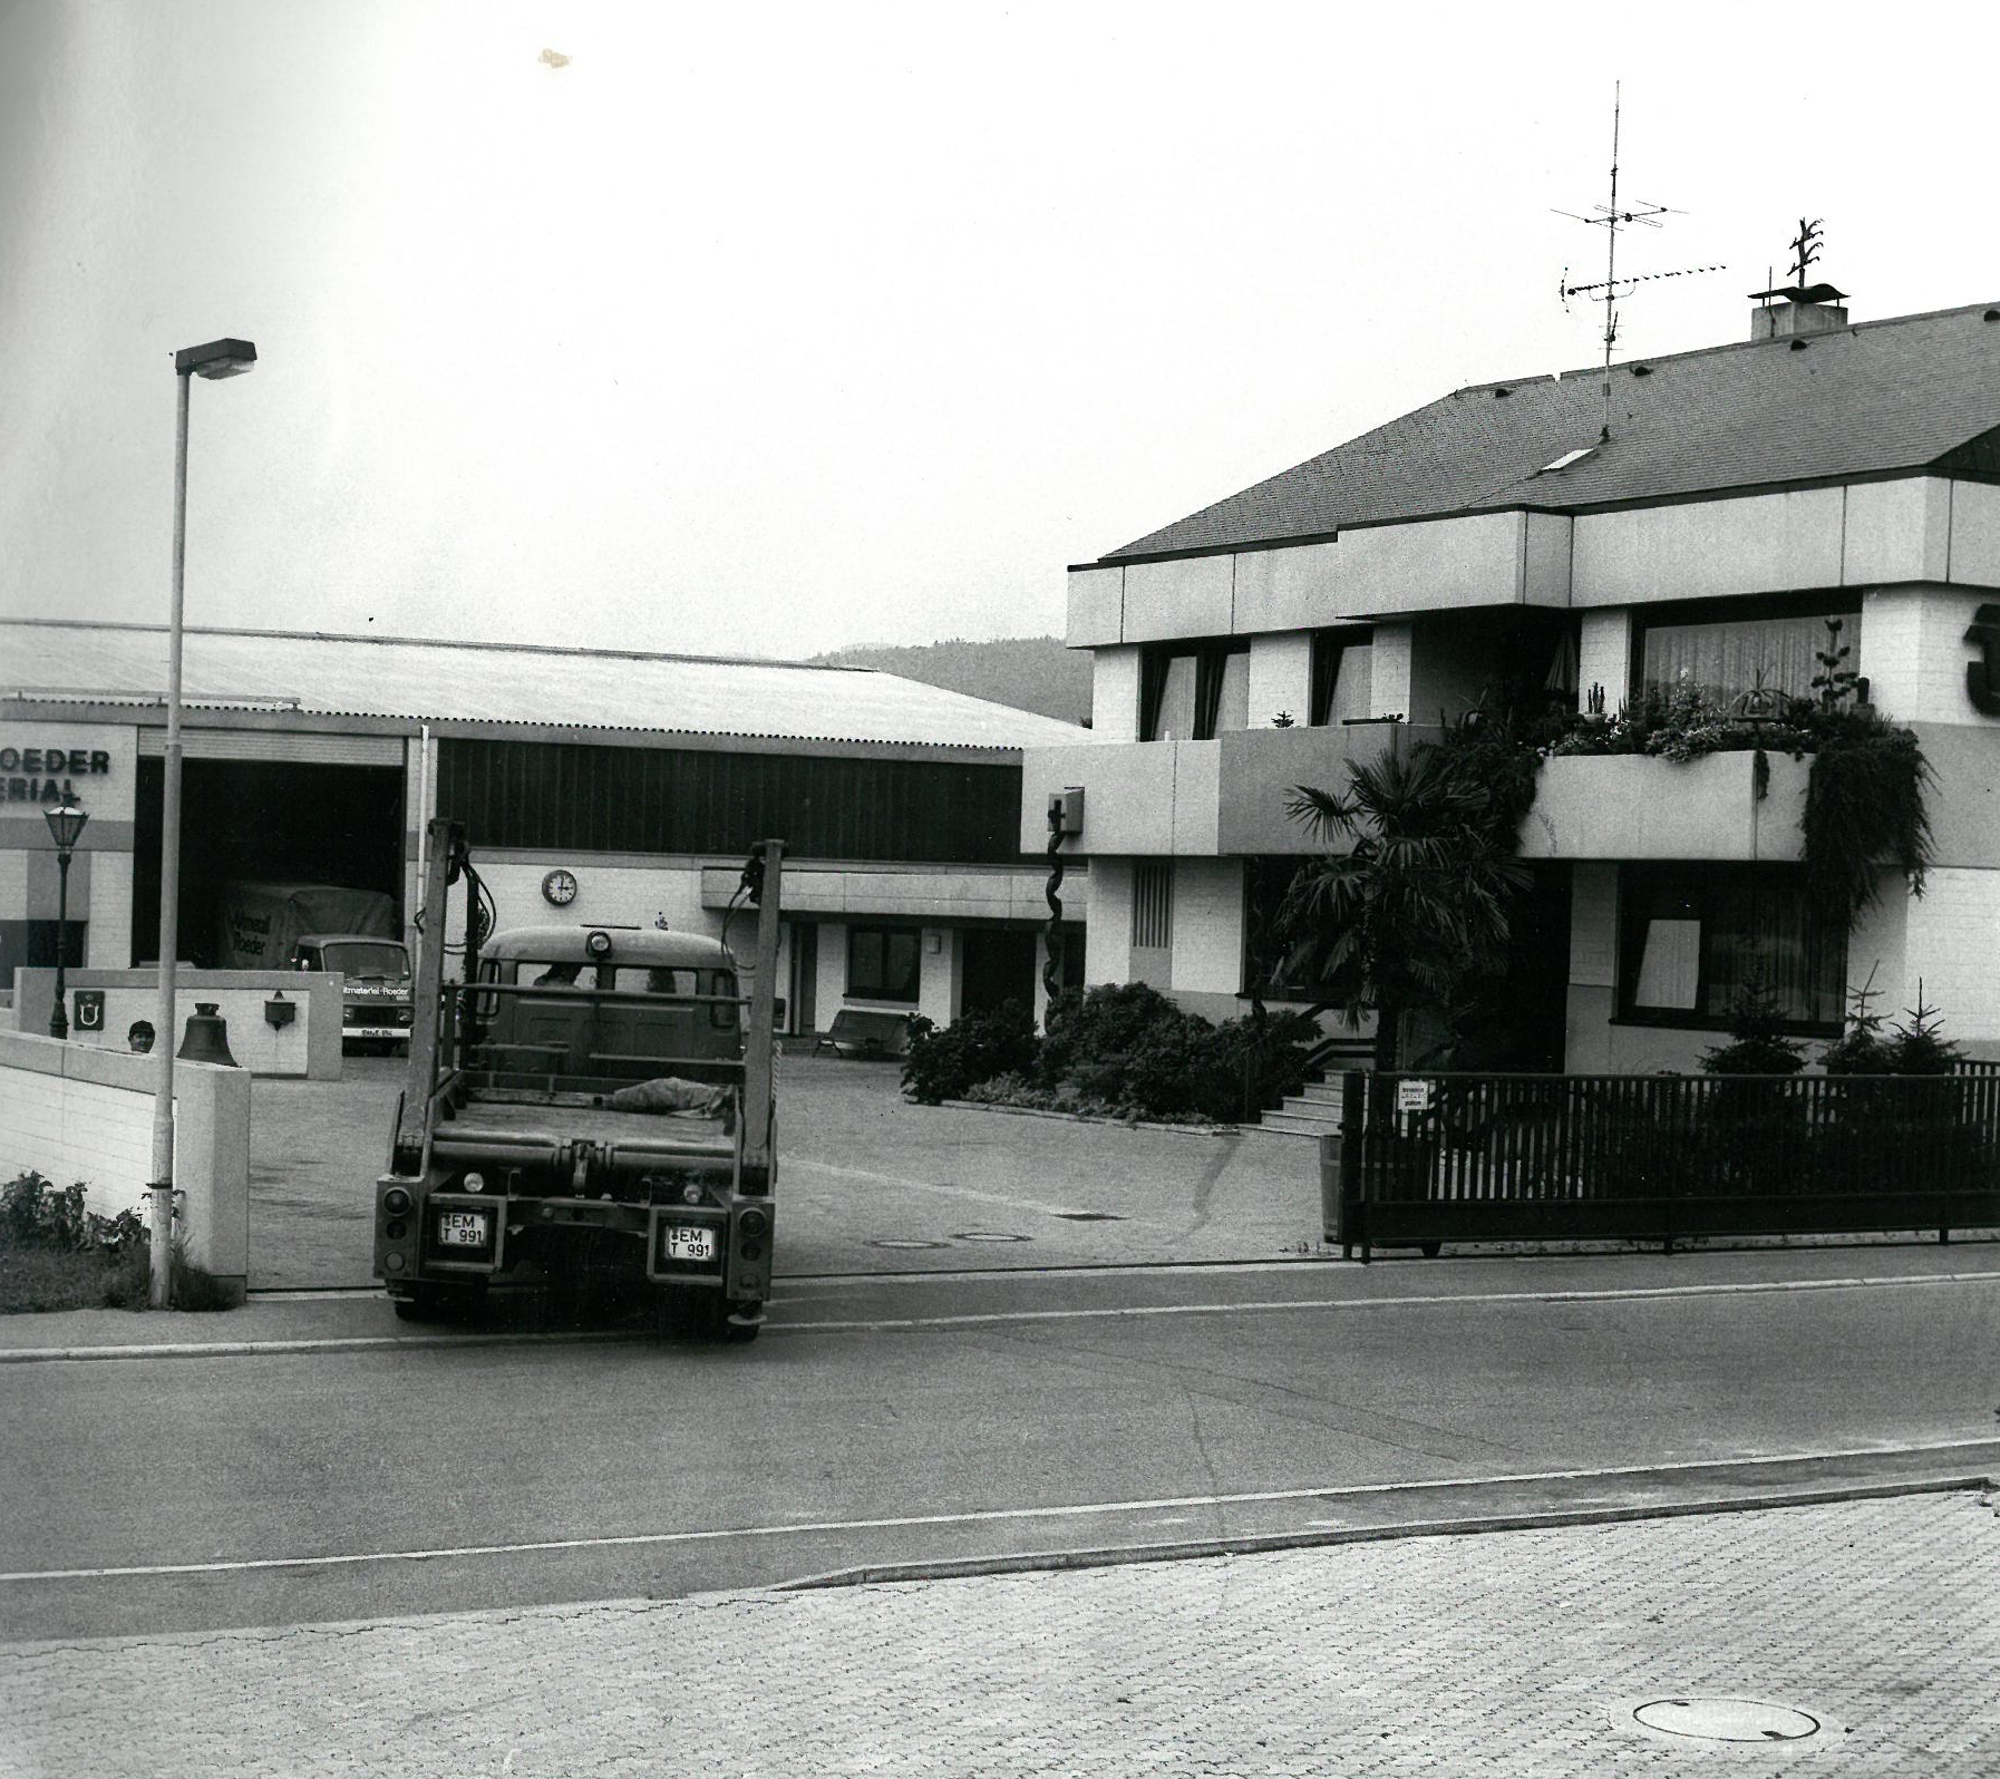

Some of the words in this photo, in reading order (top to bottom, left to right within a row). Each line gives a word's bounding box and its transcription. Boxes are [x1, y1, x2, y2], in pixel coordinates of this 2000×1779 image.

[0, 748, 109, 774] OEDER
[452, 1214, 475, 1228] EM
[443, 1227, 452, 1241] T
[459, 1229, 482, 1243] 991
[679, 1229, 702, 1243] EM
[671, 1242, 679, 1255] T
[688, 1243, 710, 1257] 991
